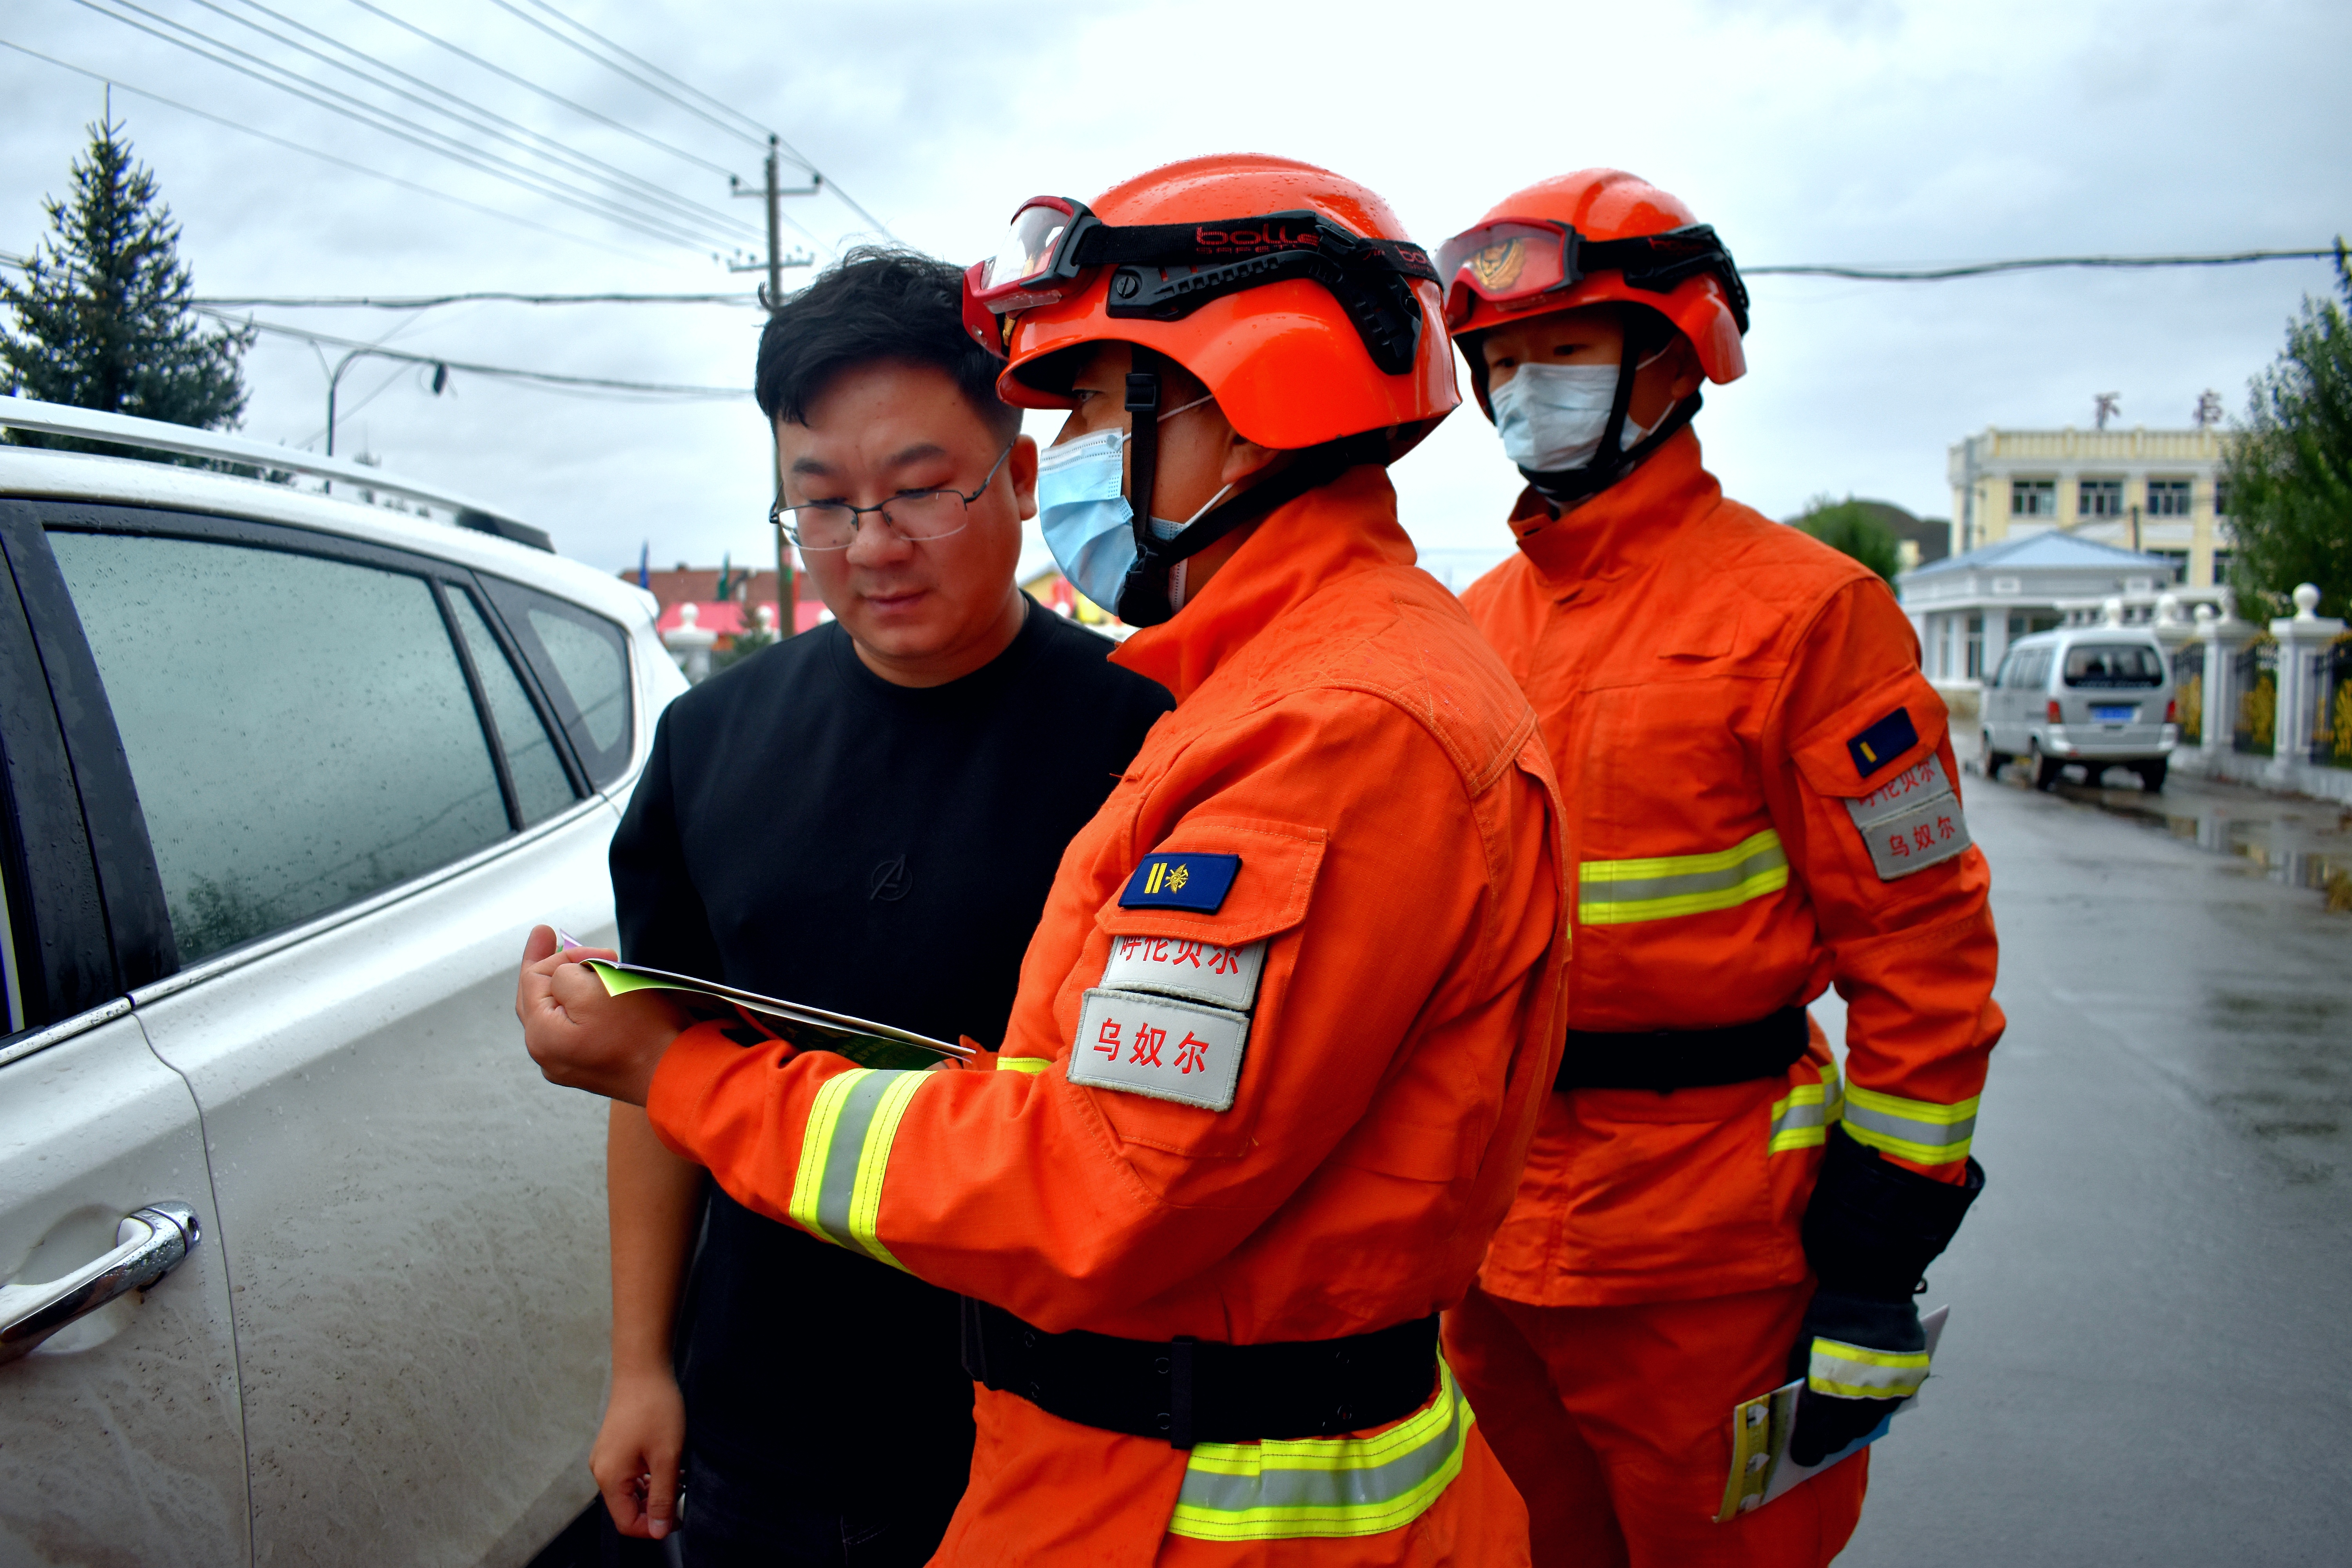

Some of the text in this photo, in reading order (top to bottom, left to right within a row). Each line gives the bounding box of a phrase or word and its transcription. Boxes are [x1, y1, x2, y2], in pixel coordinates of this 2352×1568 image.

[1196, 223, 1320, 247] bolle
[1889, 816, 1955, 857] 乌奴尔
[1093, 1017, 1209, 1074] 乌奴尔
